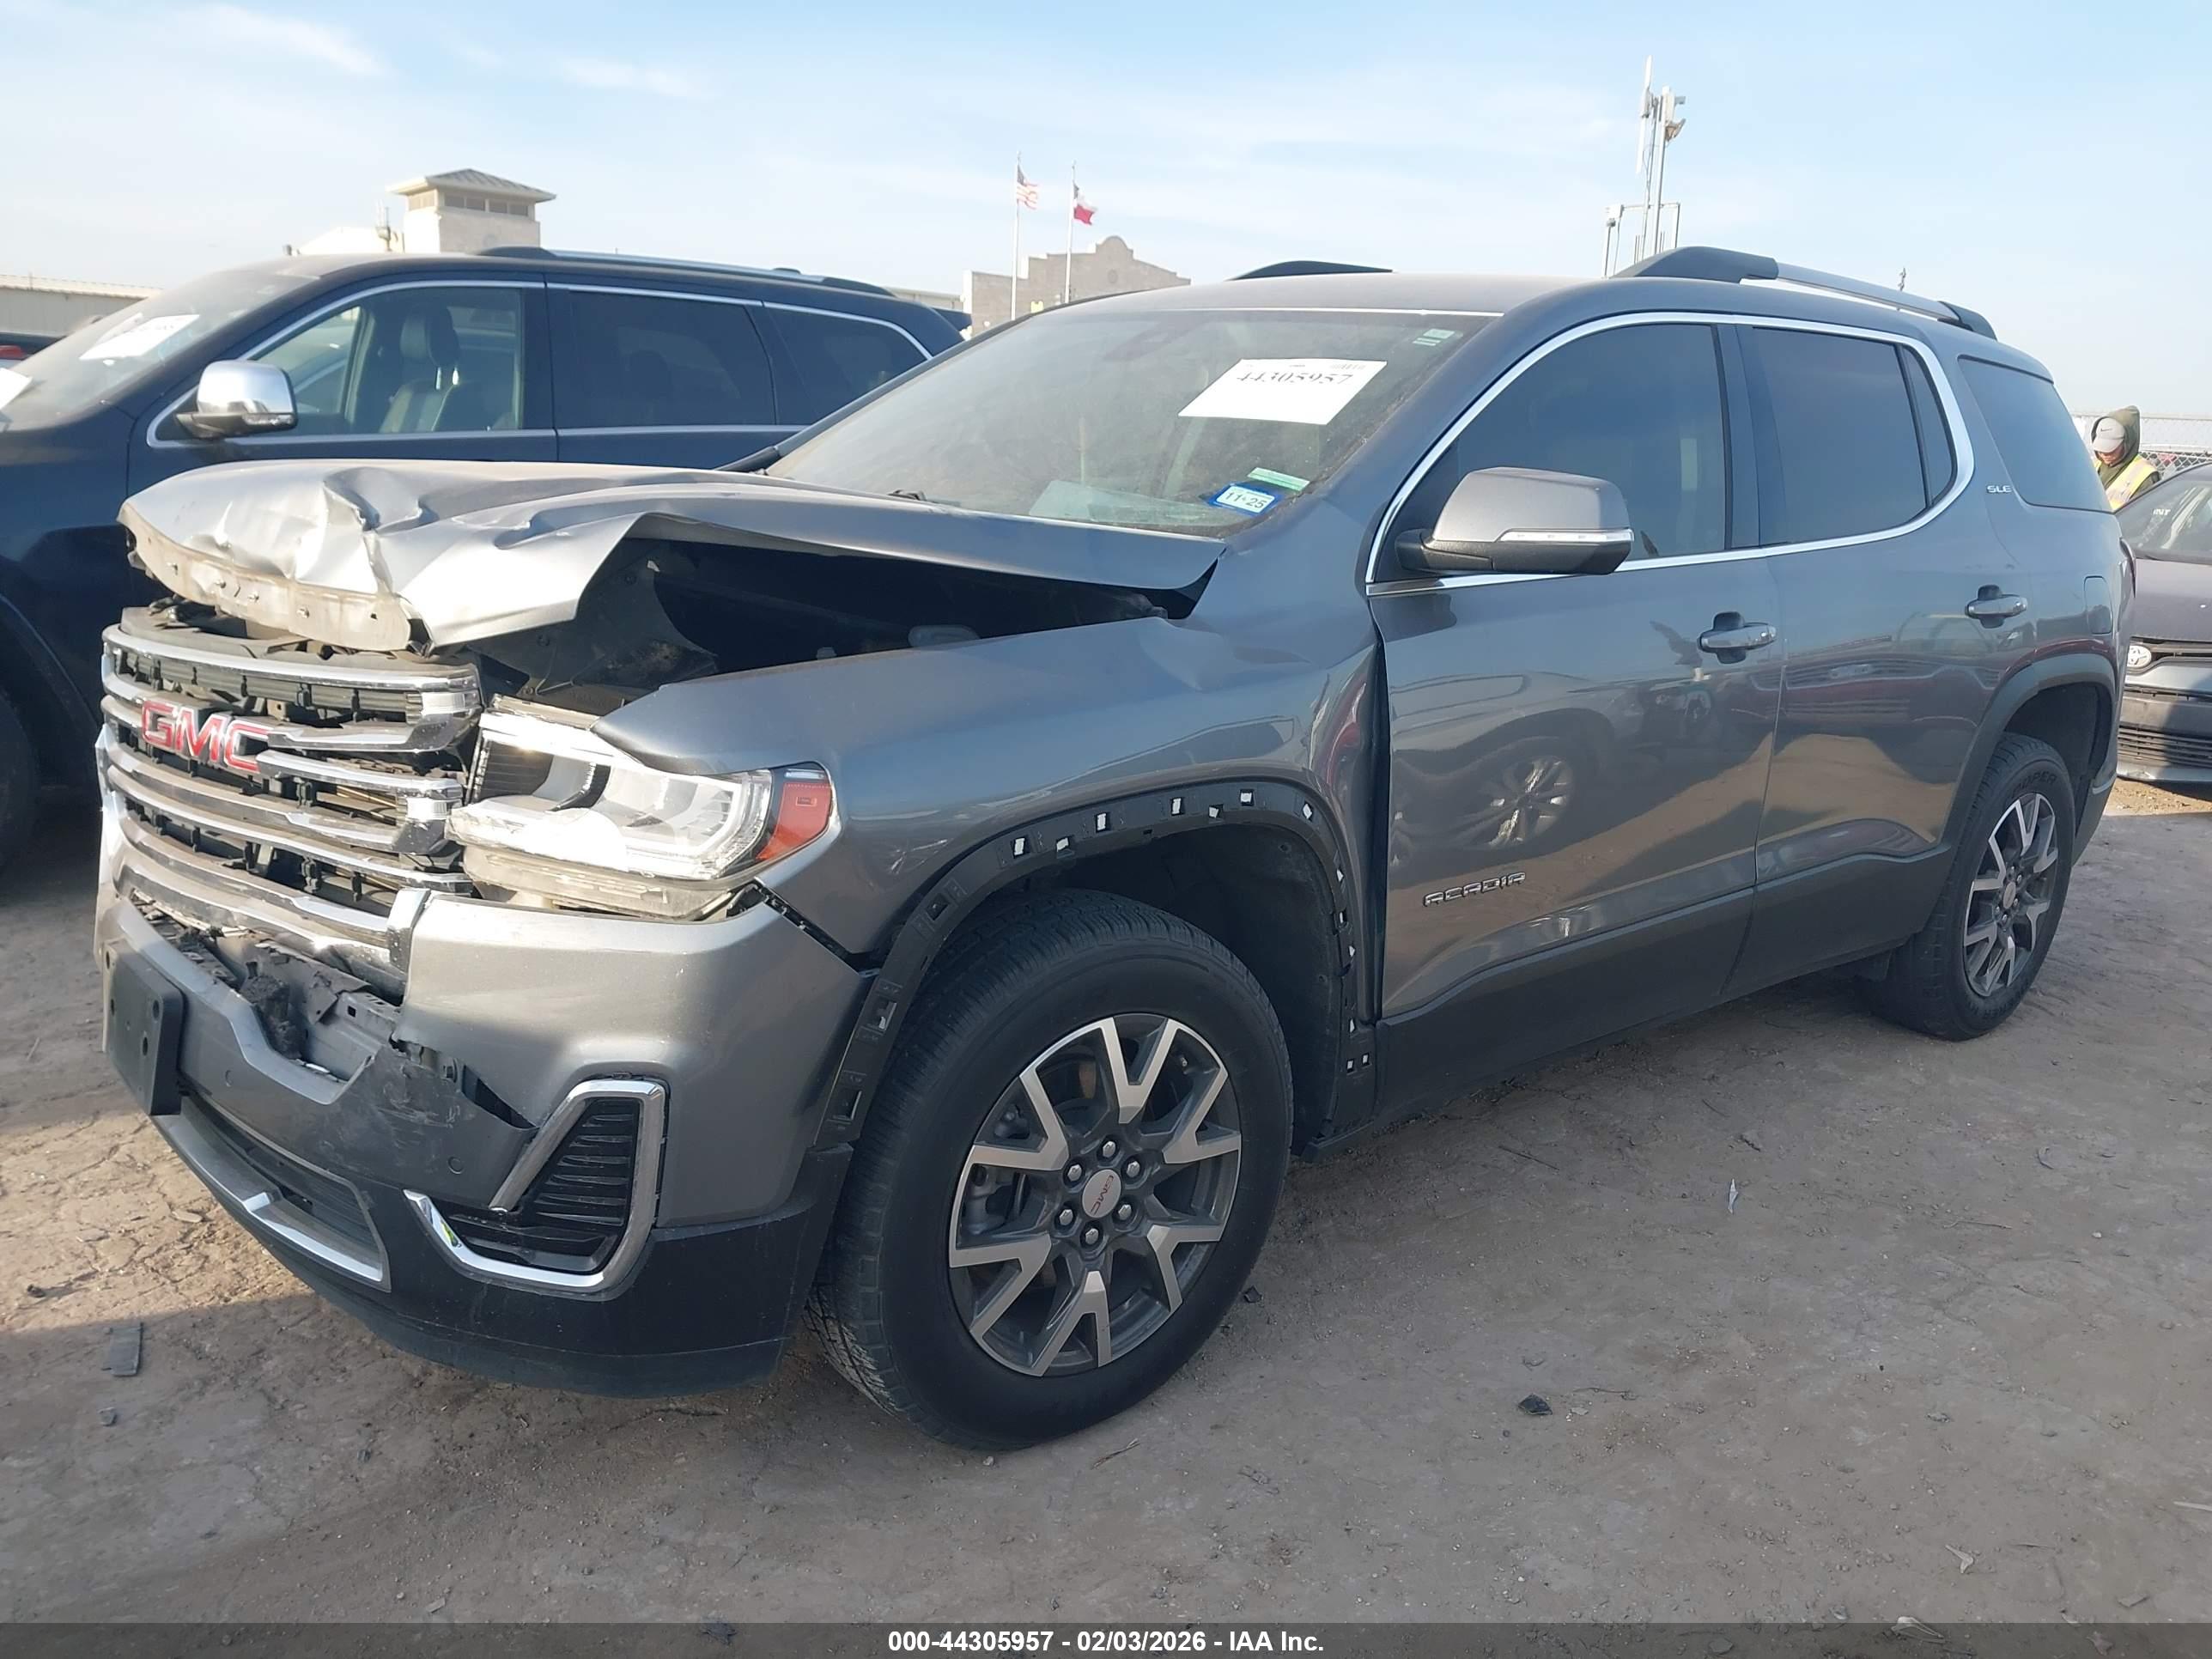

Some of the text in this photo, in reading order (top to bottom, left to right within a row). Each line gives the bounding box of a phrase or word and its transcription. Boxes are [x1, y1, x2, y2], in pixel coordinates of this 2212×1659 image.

[1986, 484, 2013, 494] SLE
[141, 699, 271, 775] GMC
[1423, 872, 1527, 907] ACADIA
[1090, 1174, 1115, 1217] GMC
